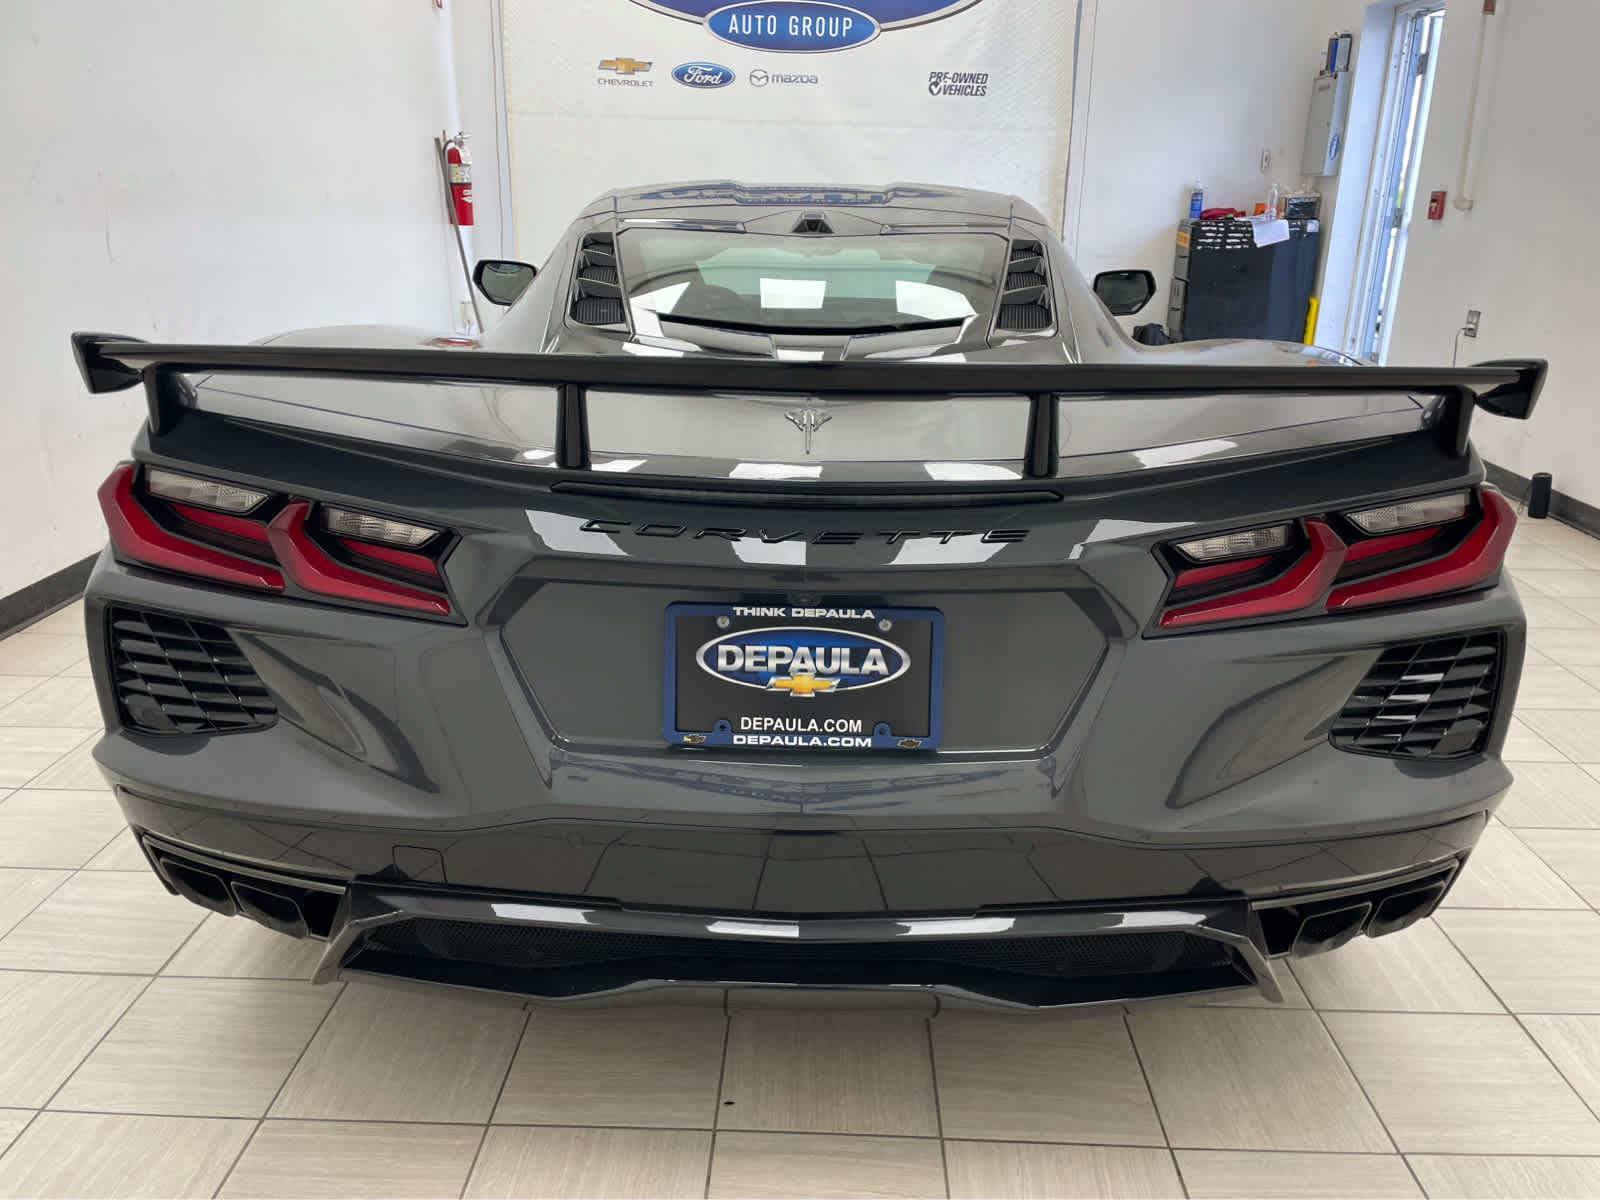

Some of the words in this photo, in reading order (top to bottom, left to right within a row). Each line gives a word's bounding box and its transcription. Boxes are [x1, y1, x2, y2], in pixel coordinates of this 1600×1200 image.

[728, 14, 777, 36] AUTO
[788, 15, 854, 37] GROUP
[683, 65, 723, 85] Ford
[928, 71, 989, 85] PRE-OWNED
[597, 78, 654, 88] CHEVROLET
[942, 84, 988, 97] VEHICLES
[579, 519, 1031, 545] CORVETTE
[732, 606, 786, 618] THINK
[791, 607, 876, 619] DEPAULA
[717, 644, 890, 676] DEPAULA
[740, 716, 863, 733] DEPAULA.COM
[732, 735, 873, 749] DEPAULA.COM
